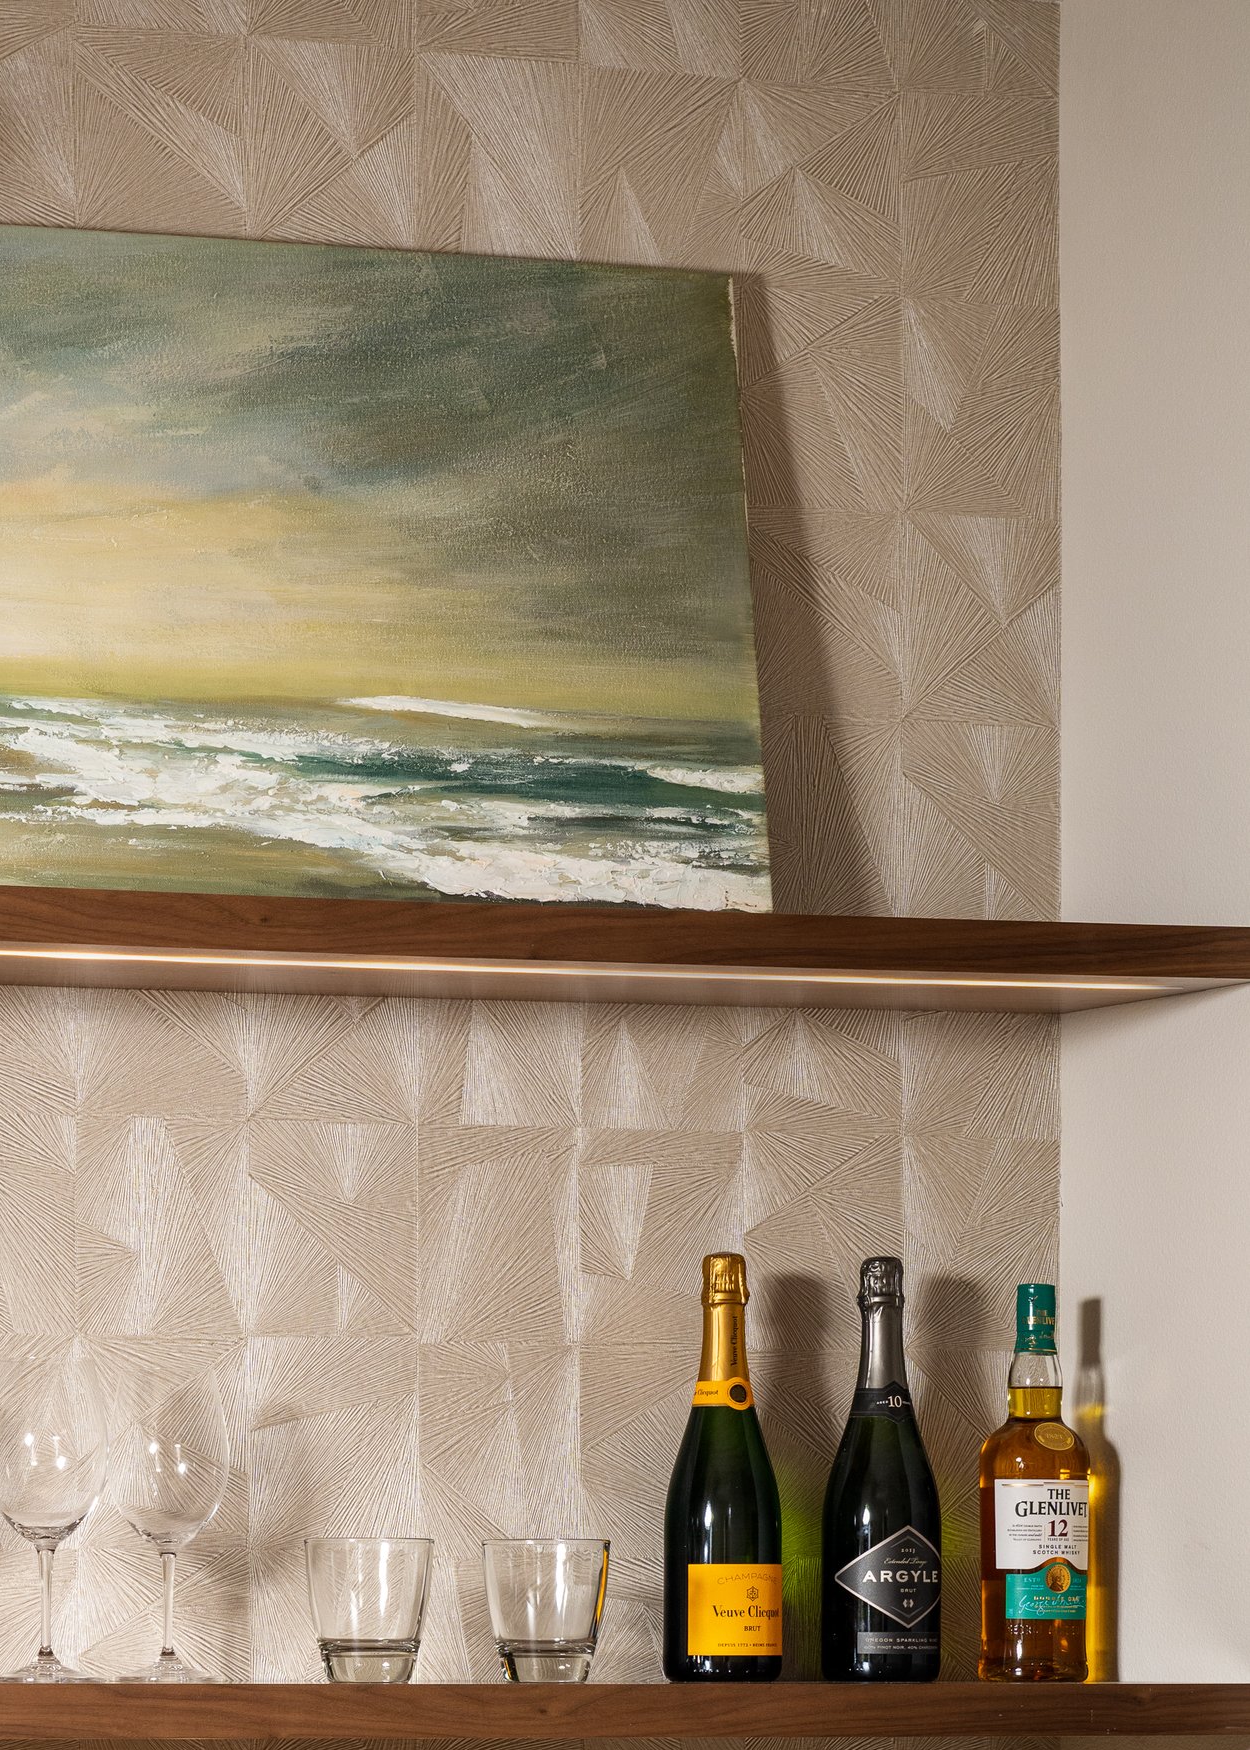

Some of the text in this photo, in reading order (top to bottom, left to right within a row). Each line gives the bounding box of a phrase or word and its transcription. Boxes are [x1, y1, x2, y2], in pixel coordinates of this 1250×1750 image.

[731, 1316, 739, 1346] Clicquot
[887, 1395, 902, 1408] 10
[1047, 1488, 1071, 1500] THE
[1015, 1501, 1088, 1518] GLENLIVET
[1048, 1519, 1069, 1537] 12
[717, 1572, 779, 1585] CHAMPAGNE
[862, 1569, 939, 1583] ARGYLE
[712, 1605, 780, 1620] Veuve Clicquot
